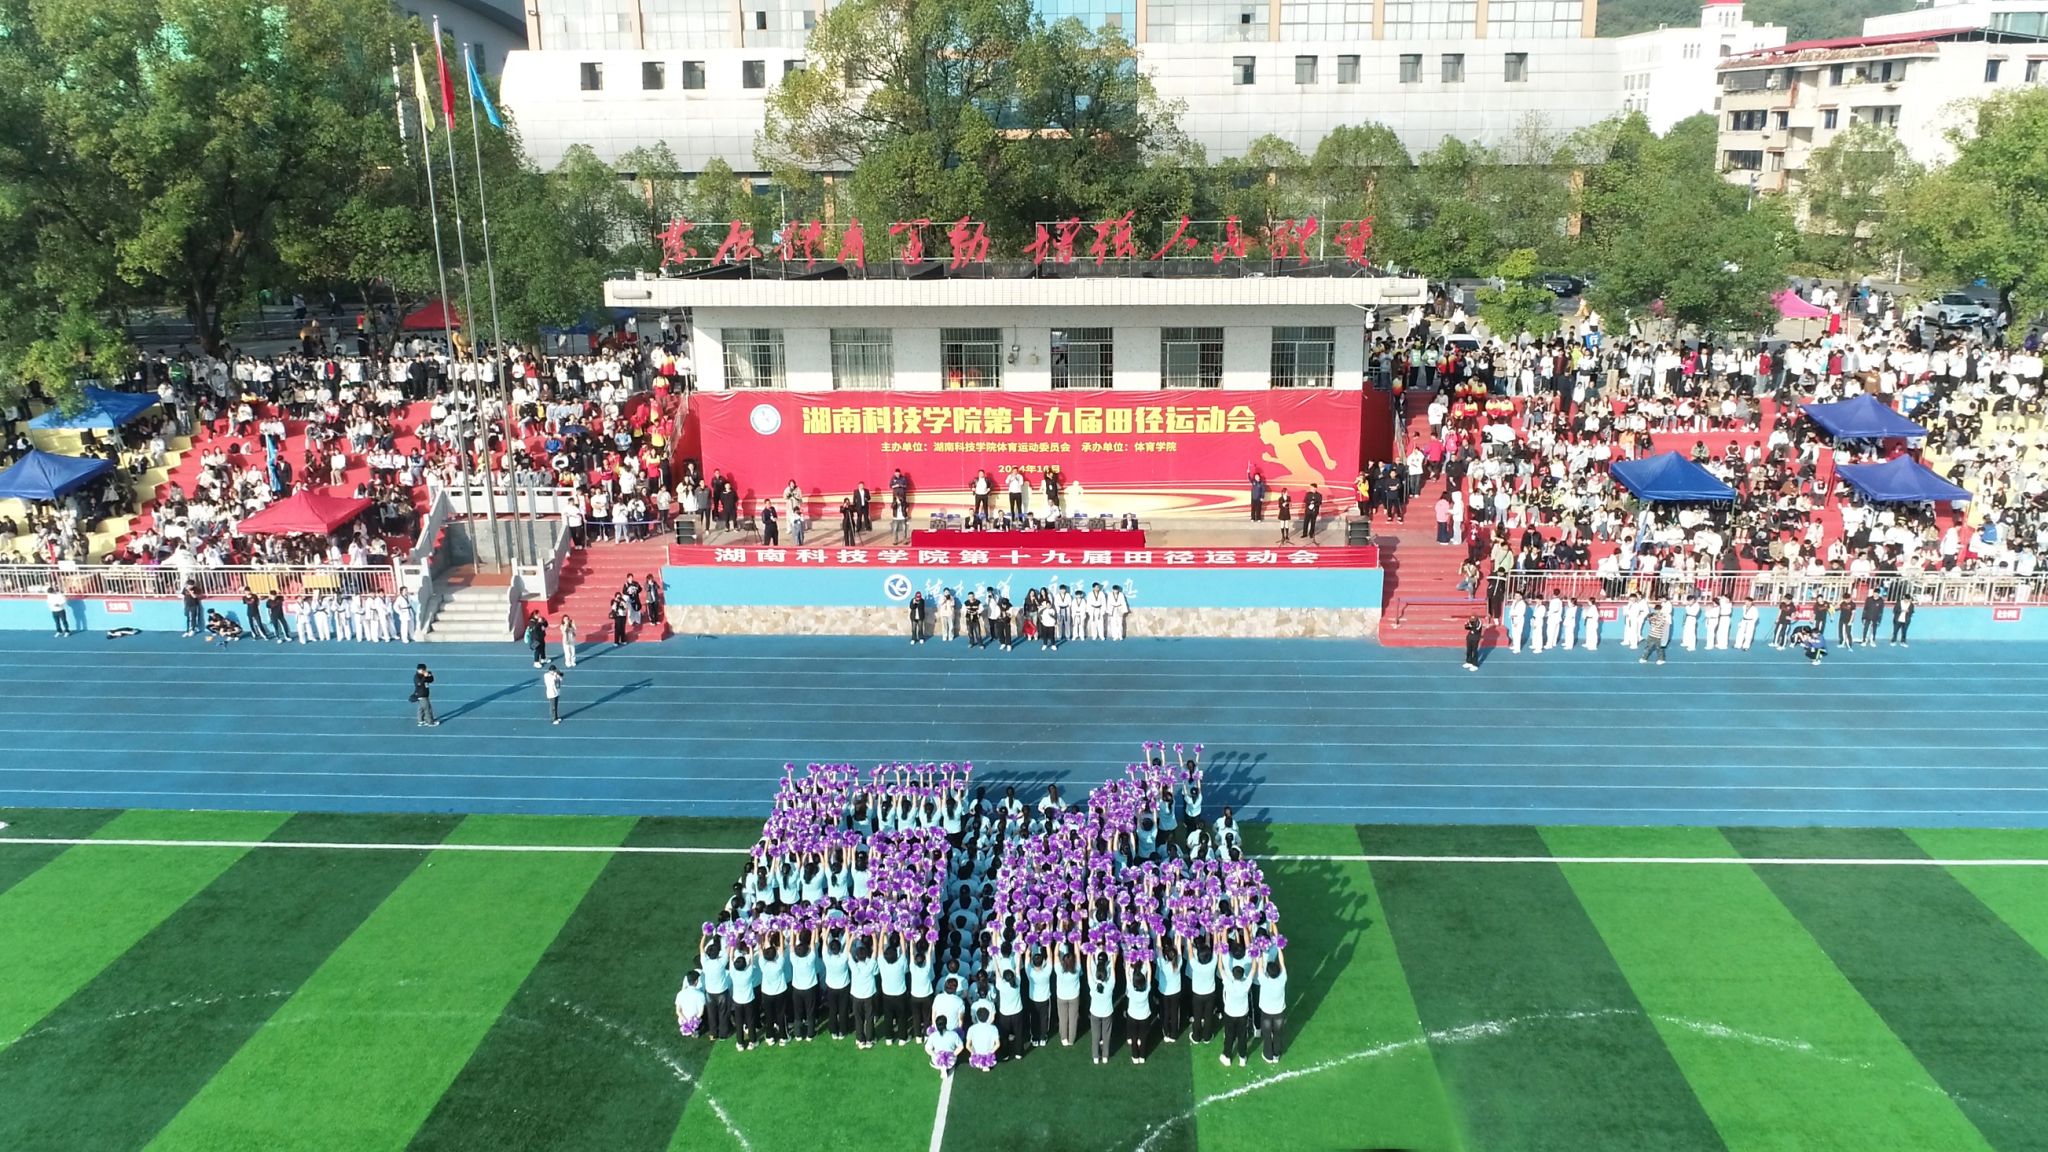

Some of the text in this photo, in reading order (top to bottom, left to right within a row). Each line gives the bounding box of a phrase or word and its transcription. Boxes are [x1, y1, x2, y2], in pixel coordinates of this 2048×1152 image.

[802, 406, 1255, 434] 湖南科技学院第十九届田径运动会
[714, 548, 1320, 564] 湖南科技学院第十九届田径运动会
